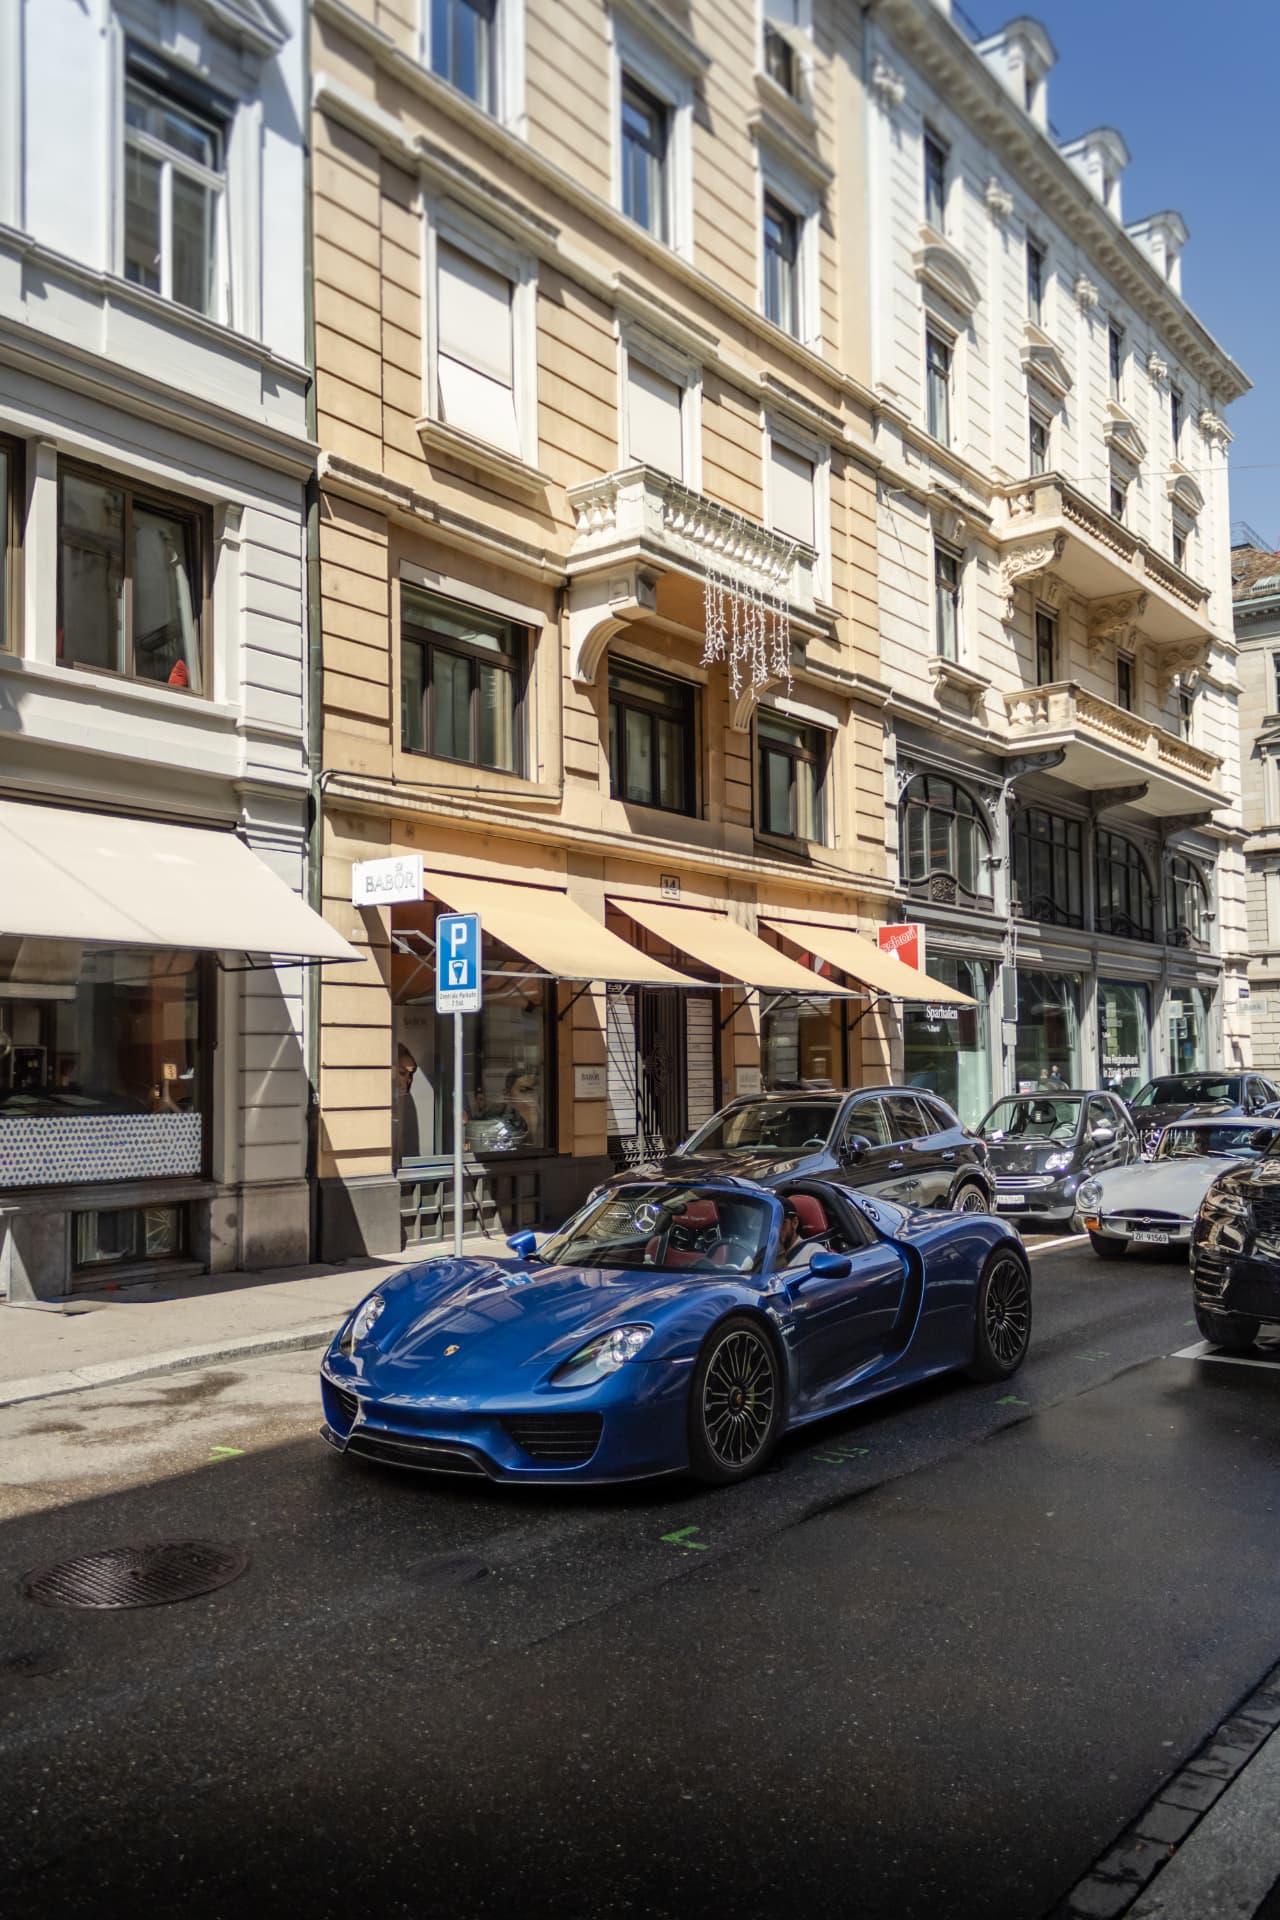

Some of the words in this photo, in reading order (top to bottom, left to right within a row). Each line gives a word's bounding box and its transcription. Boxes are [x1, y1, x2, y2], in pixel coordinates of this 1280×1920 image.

[365, 871, 416, 894] BABOR
[664, 879, 677, 895] 14
[451, 922, 467, 958] P
[926, 1004, 958, 1021] Sparhafen
[1135, 1232, 1144, 1240] ZH
[1146, 1232, 1167, 1242] 91569
